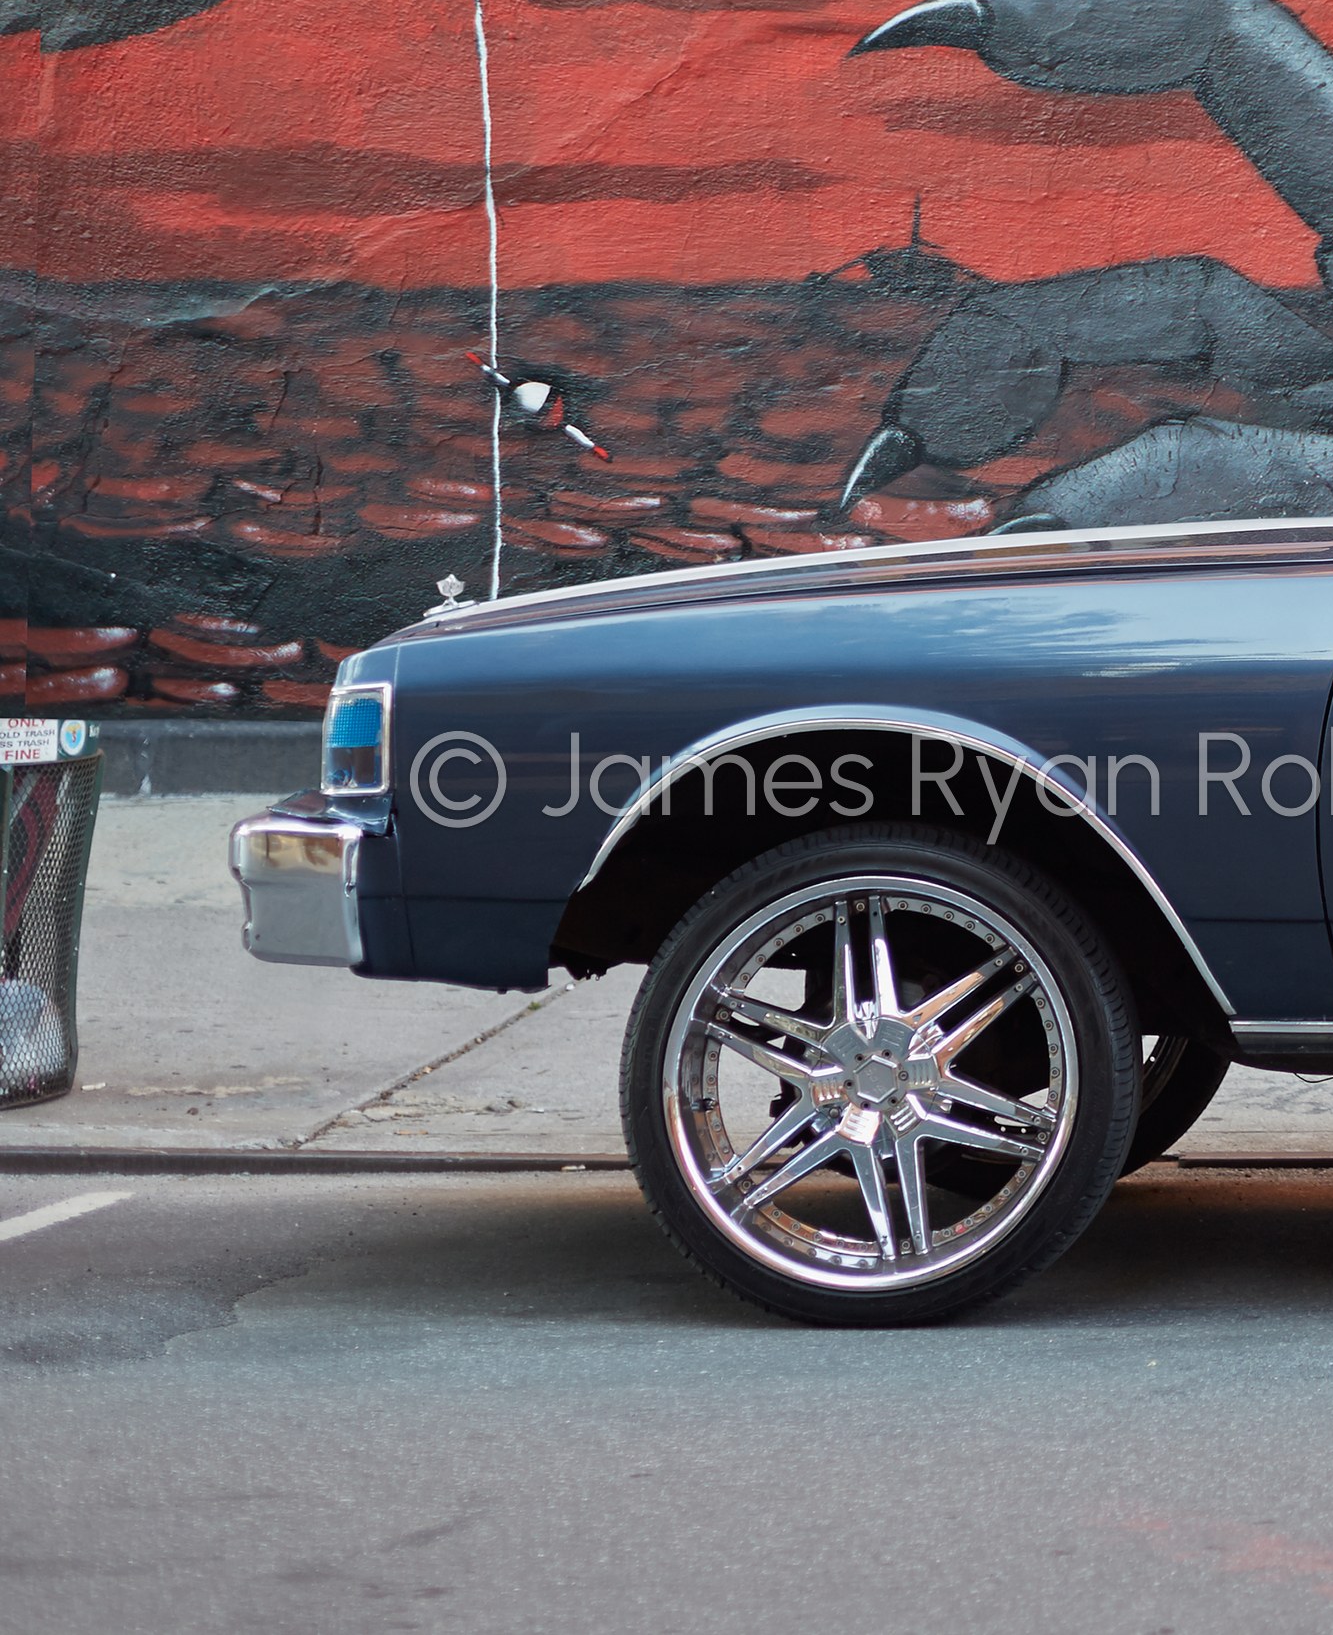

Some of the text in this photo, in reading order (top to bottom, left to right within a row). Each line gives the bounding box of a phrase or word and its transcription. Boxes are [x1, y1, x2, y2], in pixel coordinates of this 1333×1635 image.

[25, 729, 55, 737] TRASH
[18, 739, 49, 747] TRASH
[5, 749, 40, 761] FINE
